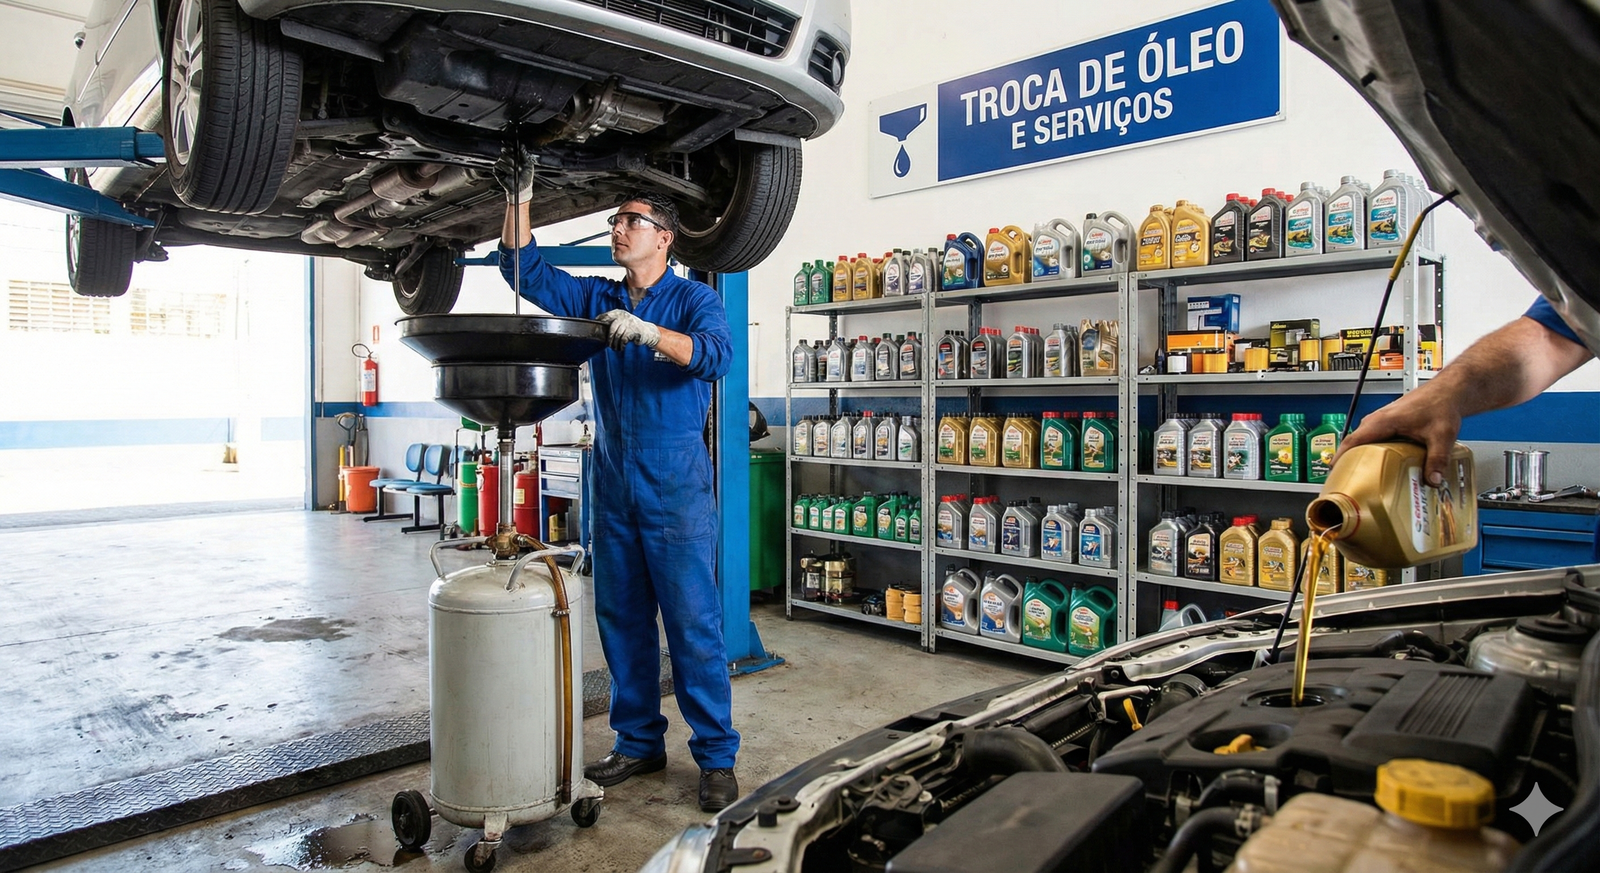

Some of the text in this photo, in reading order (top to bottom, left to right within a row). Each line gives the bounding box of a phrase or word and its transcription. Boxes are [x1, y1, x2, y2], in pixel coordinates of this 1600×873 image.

[960, 20, 1245, 126] TROCA DE ÓLEO
[1011, 87, 1174, 150] E SERVIÇOS
